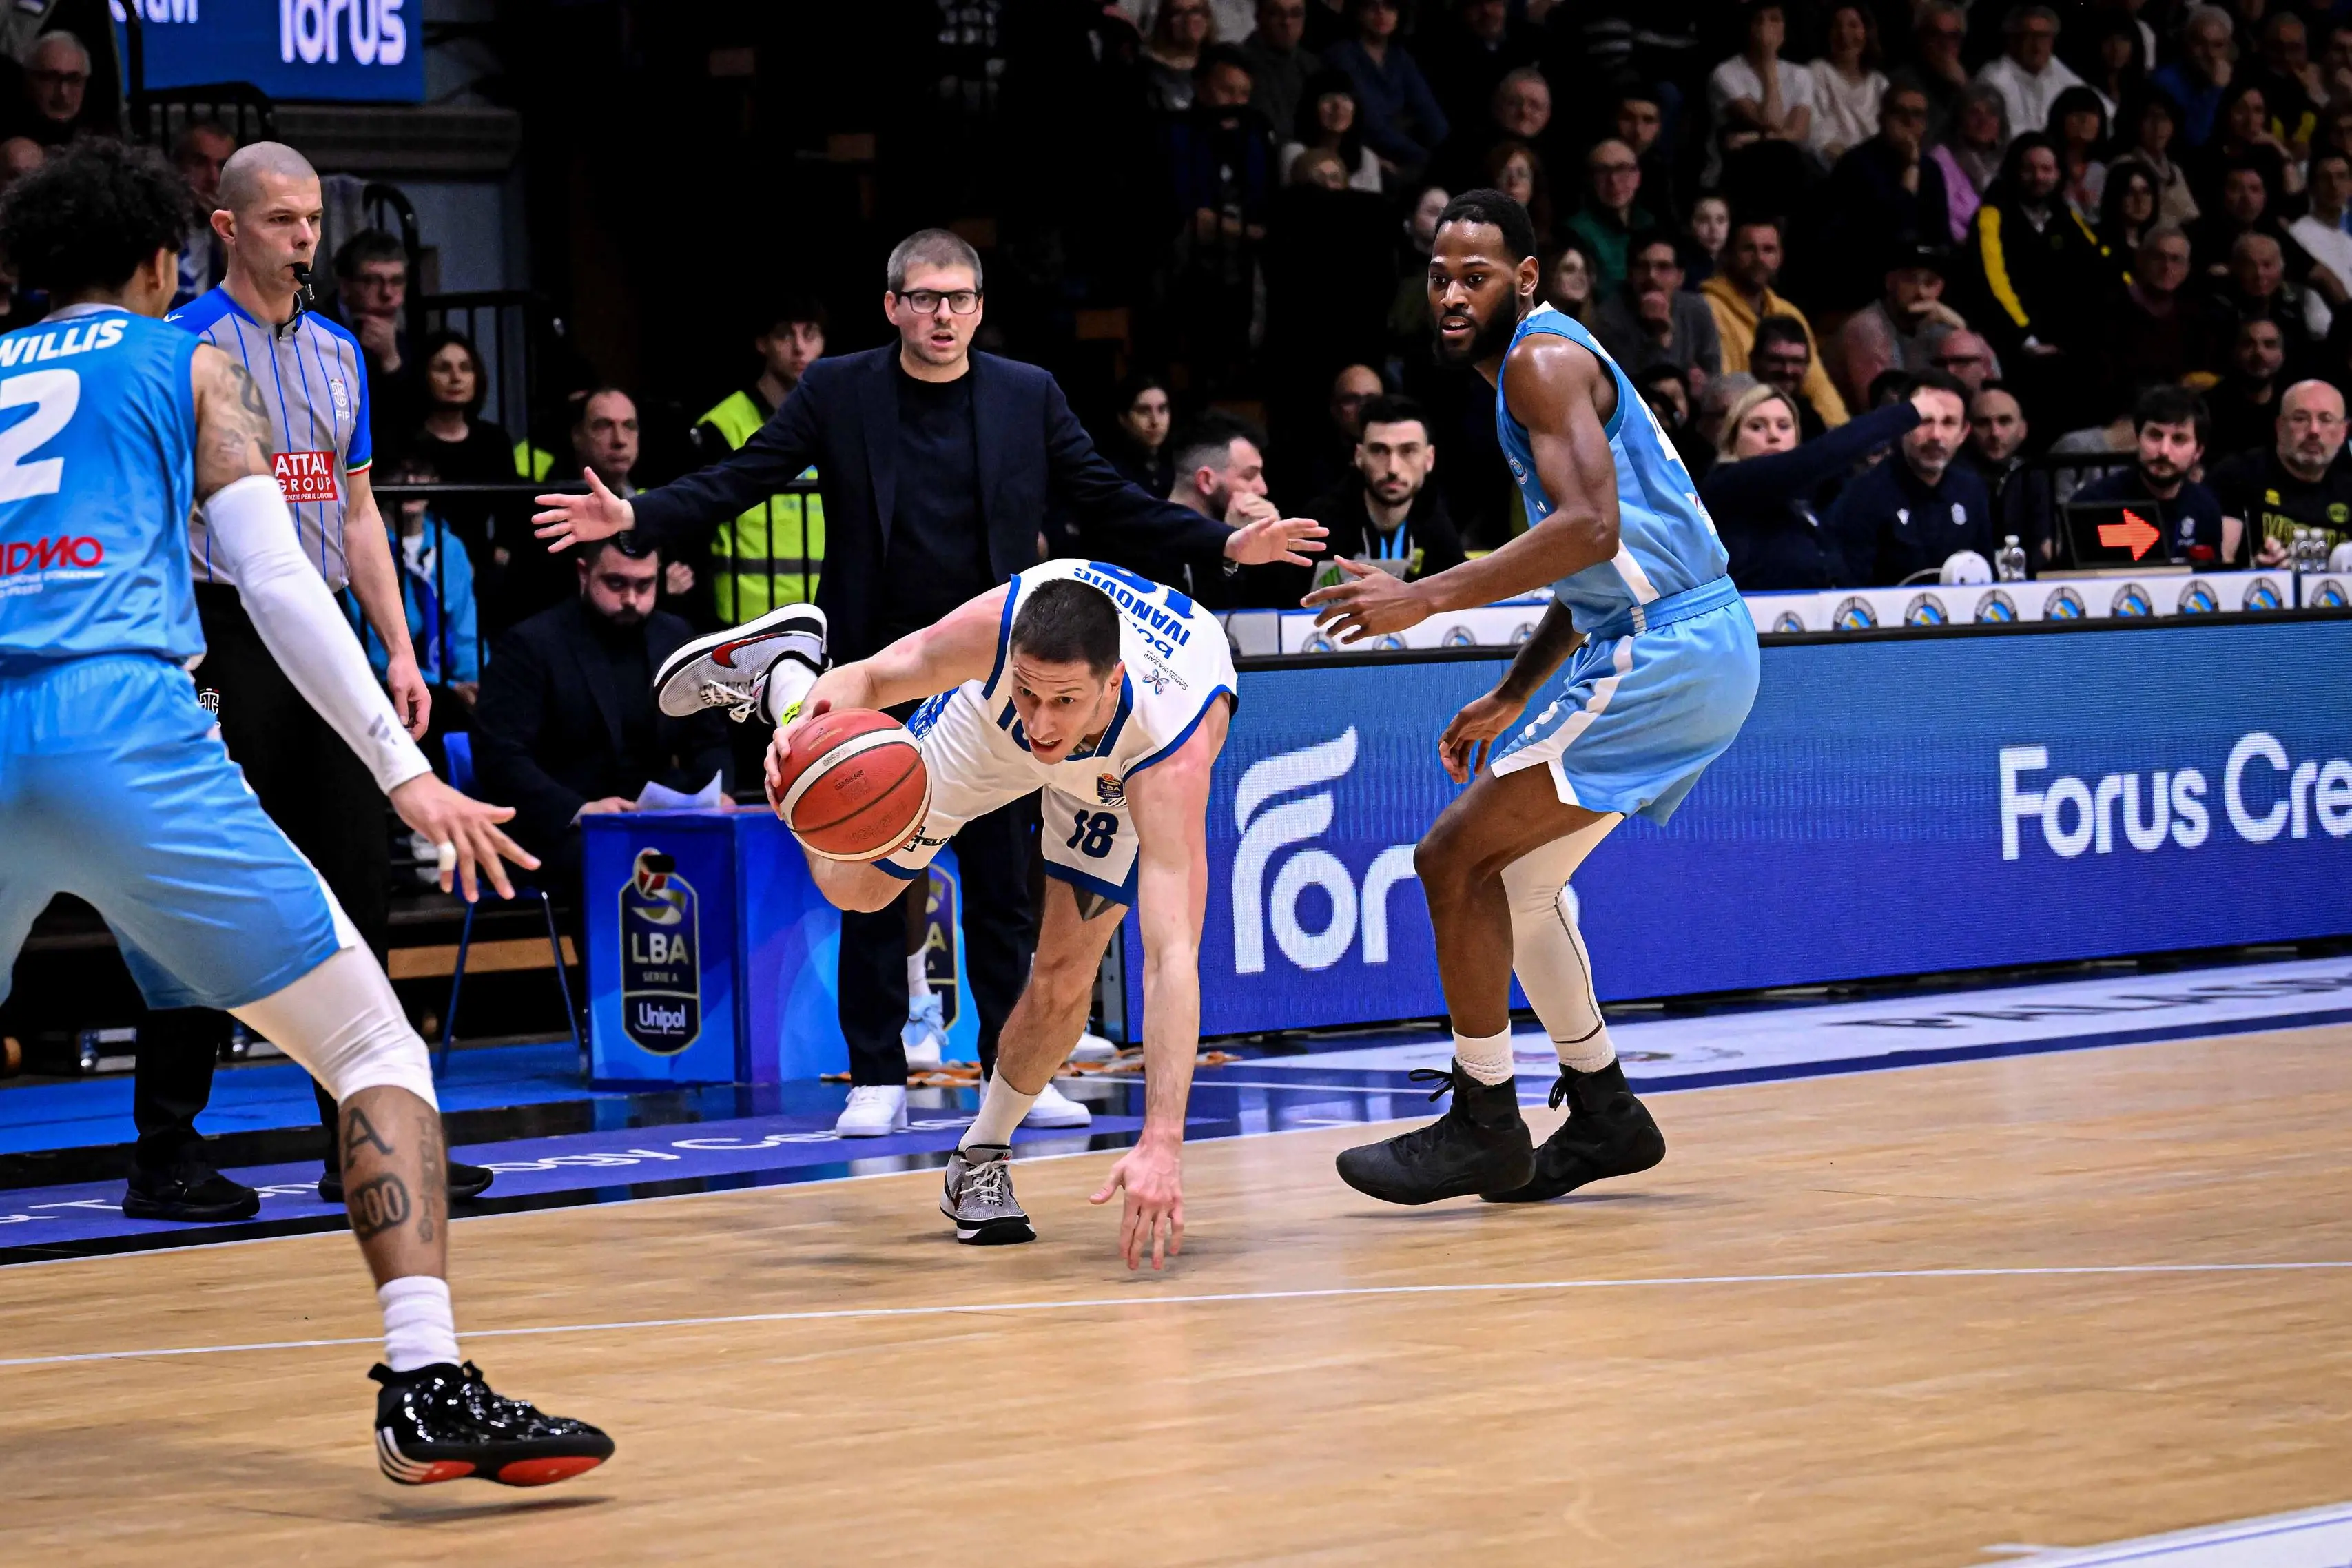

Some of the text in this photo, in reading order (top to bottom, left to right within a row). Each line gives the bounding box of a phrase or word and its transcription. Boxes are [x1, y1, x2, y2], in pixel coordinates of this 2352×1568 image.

[335, 410, 351, 421] FIP
[275, 453, 329, 477] ATTAL
[278, 477, 331, 492] GROUP
[1074, 567, 1191, 647] IVANOVIC
[1143, 652, 1187, 690] CAROLINA ZANI
[1999, 745, 2211, 861] Forus
[1066, 809, 1120, 859] 18
[630, 932, 689, 965] LBA
[642, 971, 679, 983] SERIE A
[639, 1002, 687, 1035] Unipol
